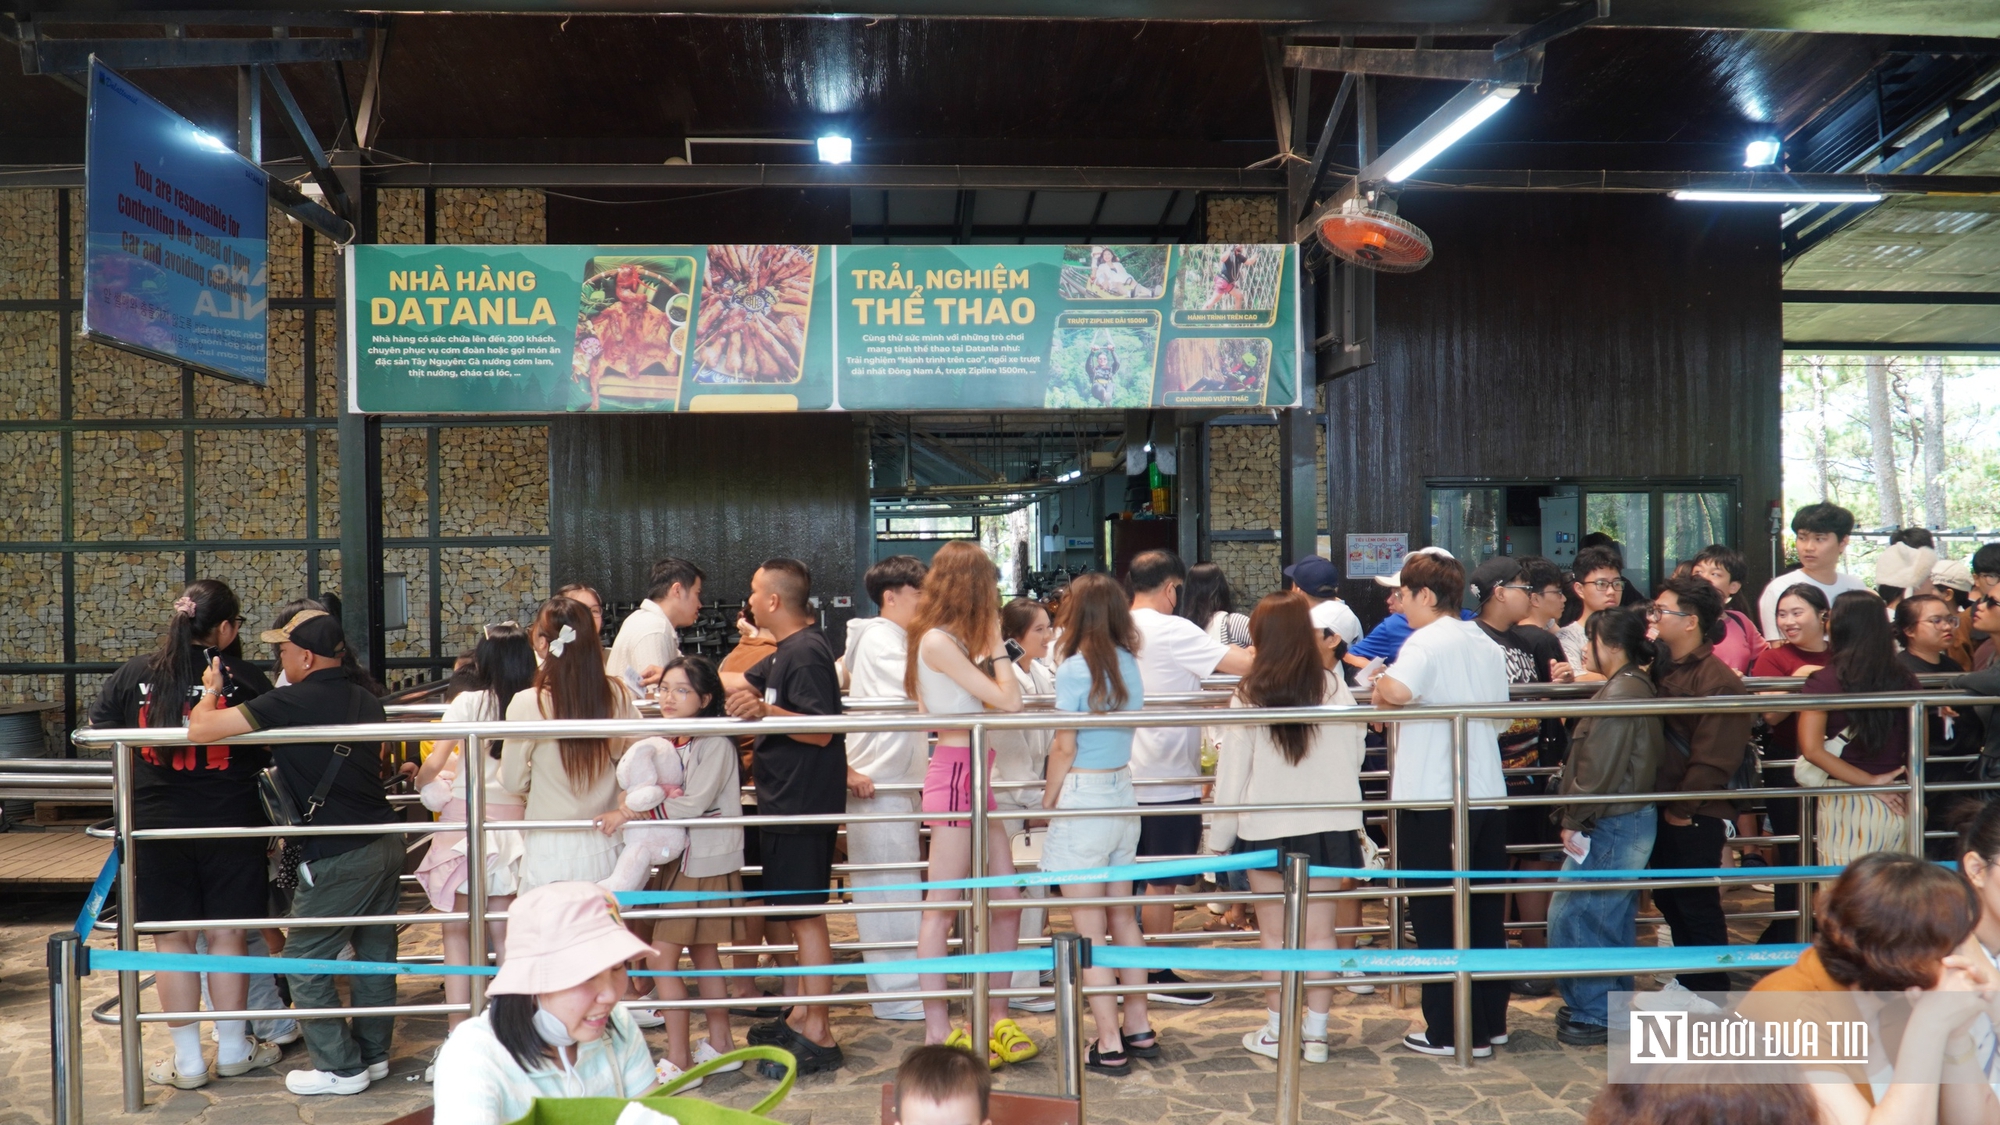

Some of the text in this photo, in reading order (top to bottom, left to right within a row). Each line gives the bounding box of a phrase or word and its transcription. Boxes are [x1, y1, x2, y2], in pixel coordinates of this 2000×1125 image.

[134, 161, 240, 239] You are responsible for
[118, 193, 251, 274] controlling the speed of your
[122, 230, 248, 303] car and avoiding collisions
[389, 264, 537, 291] NHÀ HÀNG
[851, 262, 1030, 294] TRẢI NGHIỆM
[371, 297, 557, 325] DATANLA
[851, 285, 1036, 325] THỂ THAO
[372, 335, 556, 344] Nhà hàng có sức chứa lên đến 200 khách.
[862, 333, 886, 343] Cùng
[921, 333, 944, 341] mình
[946, 333, 959, 341] với
[961, 333, 989, 342] những
[991, 333, 1005, 341] trò
[1005, 333, 1025, 341] chơi
[367, 346, 561, 356] chuyên phục vụ cơm đoàn hoặc gọi món ăn
[866, 346, 893, 354] mang
[894, 345, 912, 353] tính
[913, 344, 929, 353] thể
[930, 345, 950, 353] thao
[952, 345, 964, 354] tại
[1000, 344, 1021, 352] như:
[375, 357, 554, 367] đặc sản Tây Nguyên: Gà nướng cơm lam,
[851, 367, 865, 375] dài
[866, 367, 886, 375] nhất
[888, 367, 911, 376] Đông
[913, 367, 933, 375] Nam
[935, 366, 944, 375] Á,
[945, 367, 967, 376] trượt
[968, 366, 997, 375] Zipline
[999, 366, 1028, 375] 1500m,
[408, 369, 425, 378] thịt
[426, 369, 458, 378] nướng,
[459, 369, 482, 377] cháo
[483, 369, 494, 377] cá
[496, 369, 512, 377] lóc,
